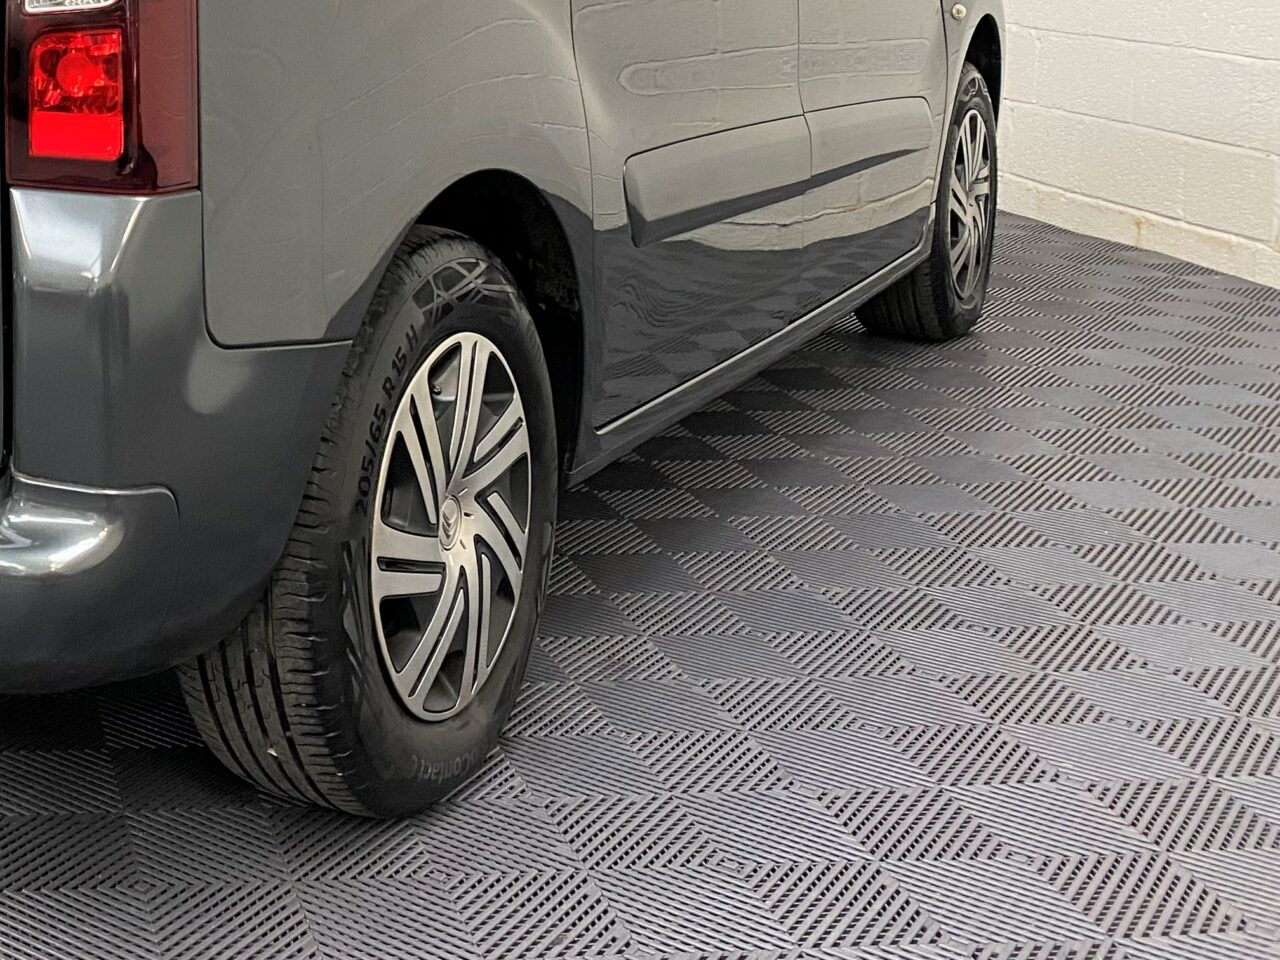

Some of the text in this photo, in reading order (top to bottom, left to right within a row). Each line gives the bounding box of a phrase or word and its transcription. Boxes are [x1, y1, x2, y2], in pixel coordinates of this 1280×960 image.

[355, 324, 419, 517] 205/65 R 15 H
